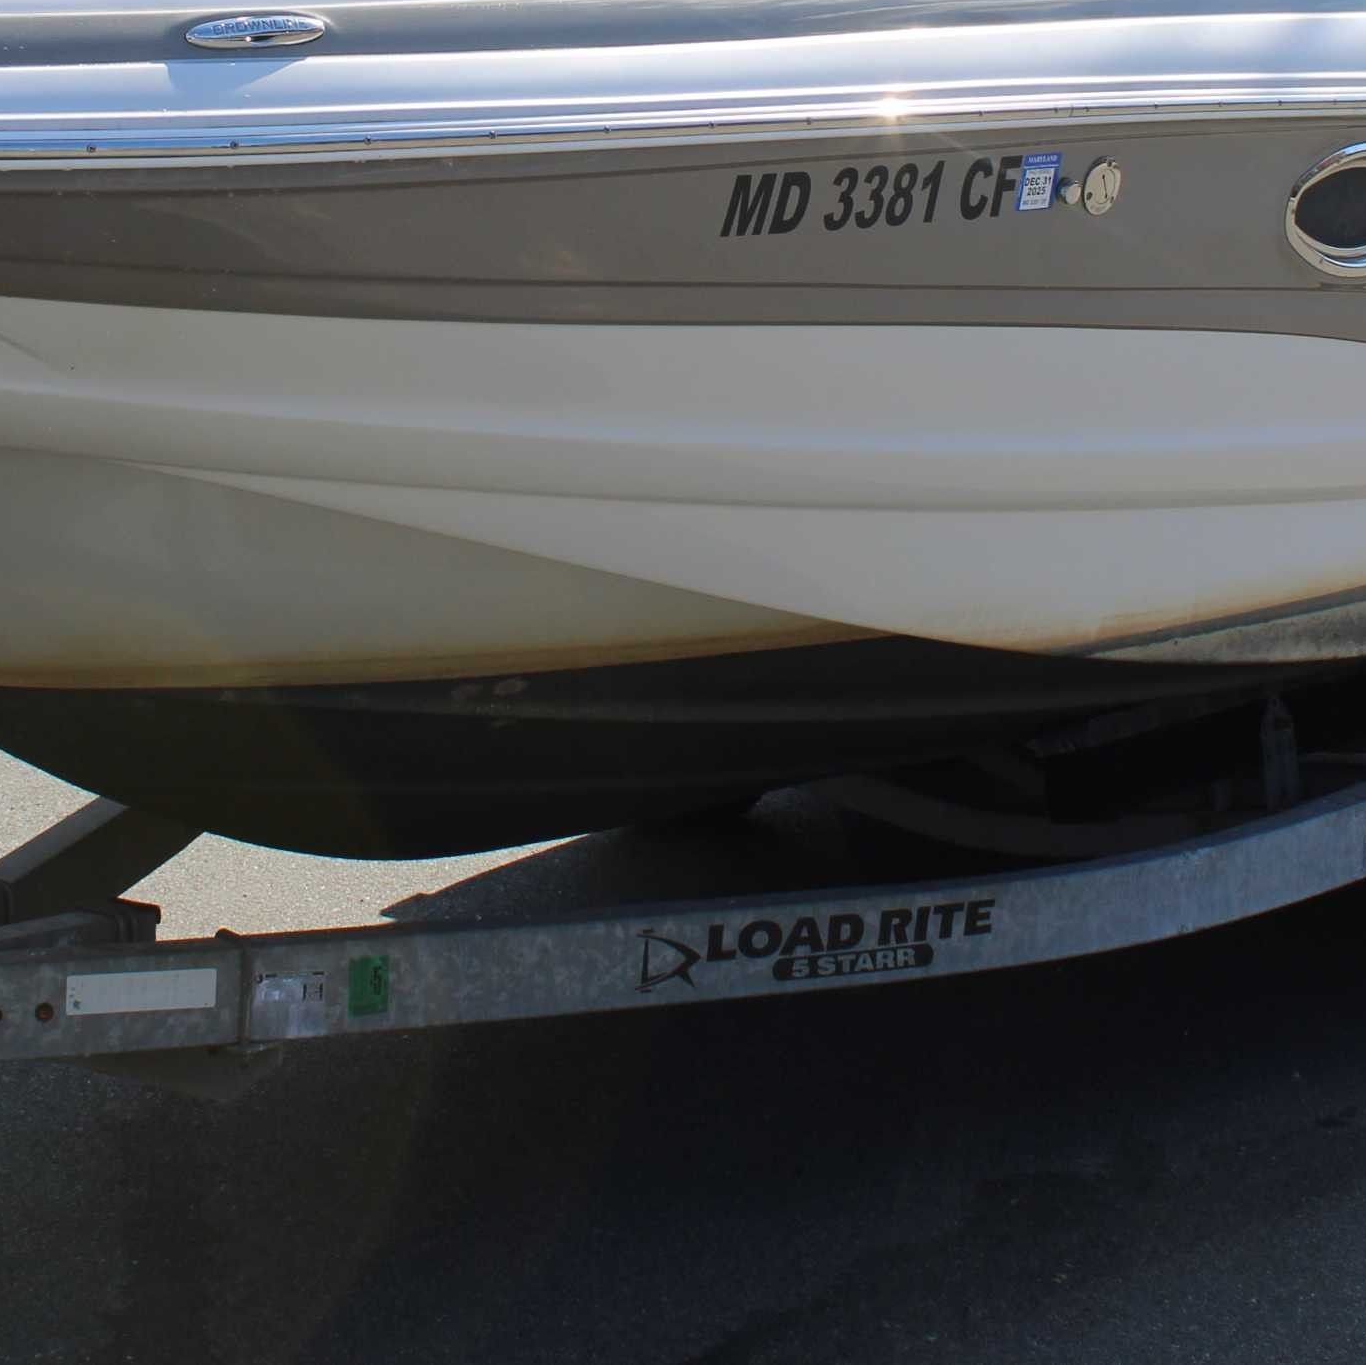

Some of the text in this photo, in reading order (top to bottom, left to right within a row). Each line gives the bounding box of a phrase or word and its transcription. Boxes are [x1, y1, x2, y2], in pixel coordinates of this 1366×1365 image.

[719, 154, 1024, 238] MD 3381 CF
[707, 899, 996, 961] LOAD RITE
[793, 947, 916, 978] 5 STARR
